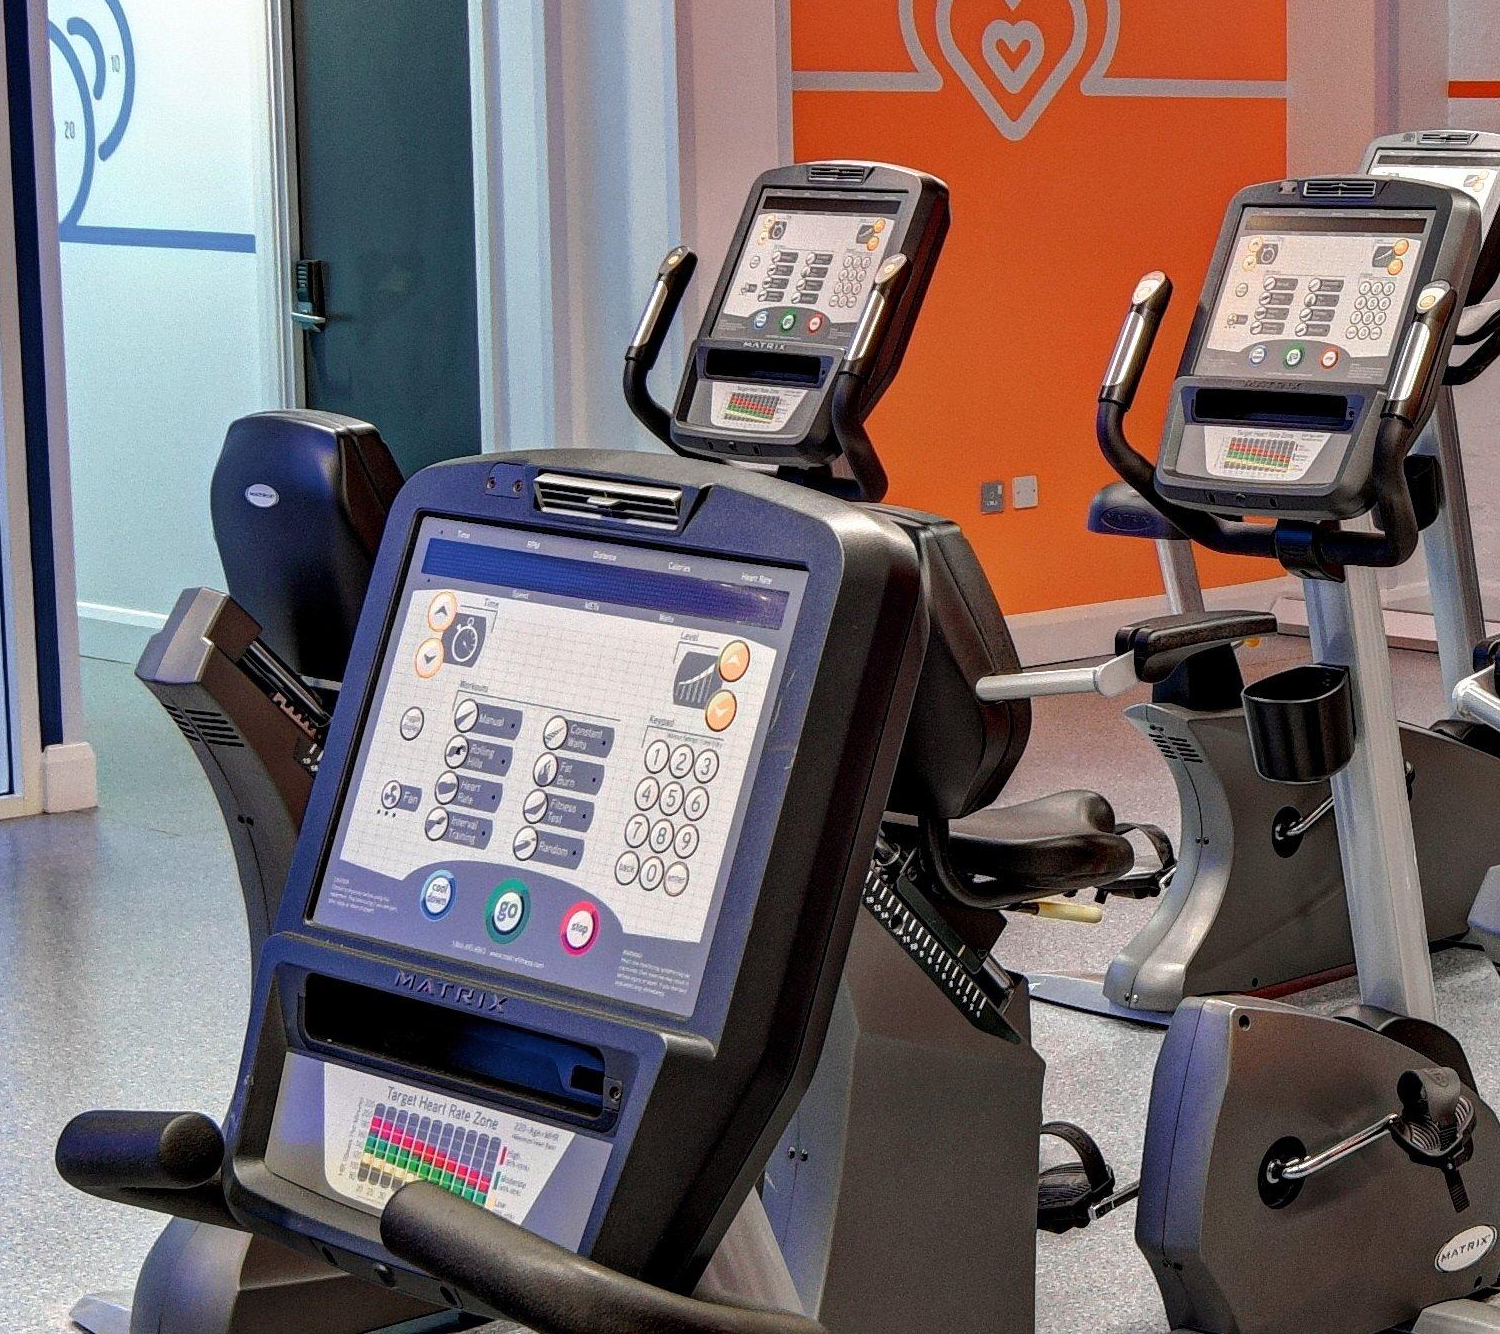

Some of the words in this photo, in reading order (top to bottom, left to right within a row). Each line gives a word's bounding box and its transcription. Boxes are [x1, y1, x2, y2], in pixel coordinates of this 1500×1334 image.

[110, 54, 121, 73] 10
[64, 120, 76, 140] 20
[742, 340, 788, 352] MATRIX
[570, 723, 603, 740] Constant
[560, 761, 572, 773] Fat
[676, 753, 687, 771] 2
[701, 758, 711, 776] 3
[461, 780, 481, 793] Heart
[403, 791, 418, 806] Fan
[551, 798, 577, 813] Fitness
[641, 786, 651, 803] 4
[666, 790, 677, 808] 5
[691, 795, 701, 812] 6
[633, 822, 643, 839] 7
[657, 827, 667, 845] 8
[681, 832, 692, 850] 9
[538, 841, 569, 857] Random
[646, 865, 657, 882] 0
[431, 882, 448, 895] cool
[497, 899, 518, 922] go
[570, 922, 590, 935] stop
[394, 970, 512, 1014] MATRIX
[388, 1085, 417, 1107] Target
[419, 1096, 447, 1115] Heart
[450, 1104, 471, 1122] Rate
[473, 1111, 499, 1131] Zone
[1437, 1233, 1491, 1264] MATRIX
